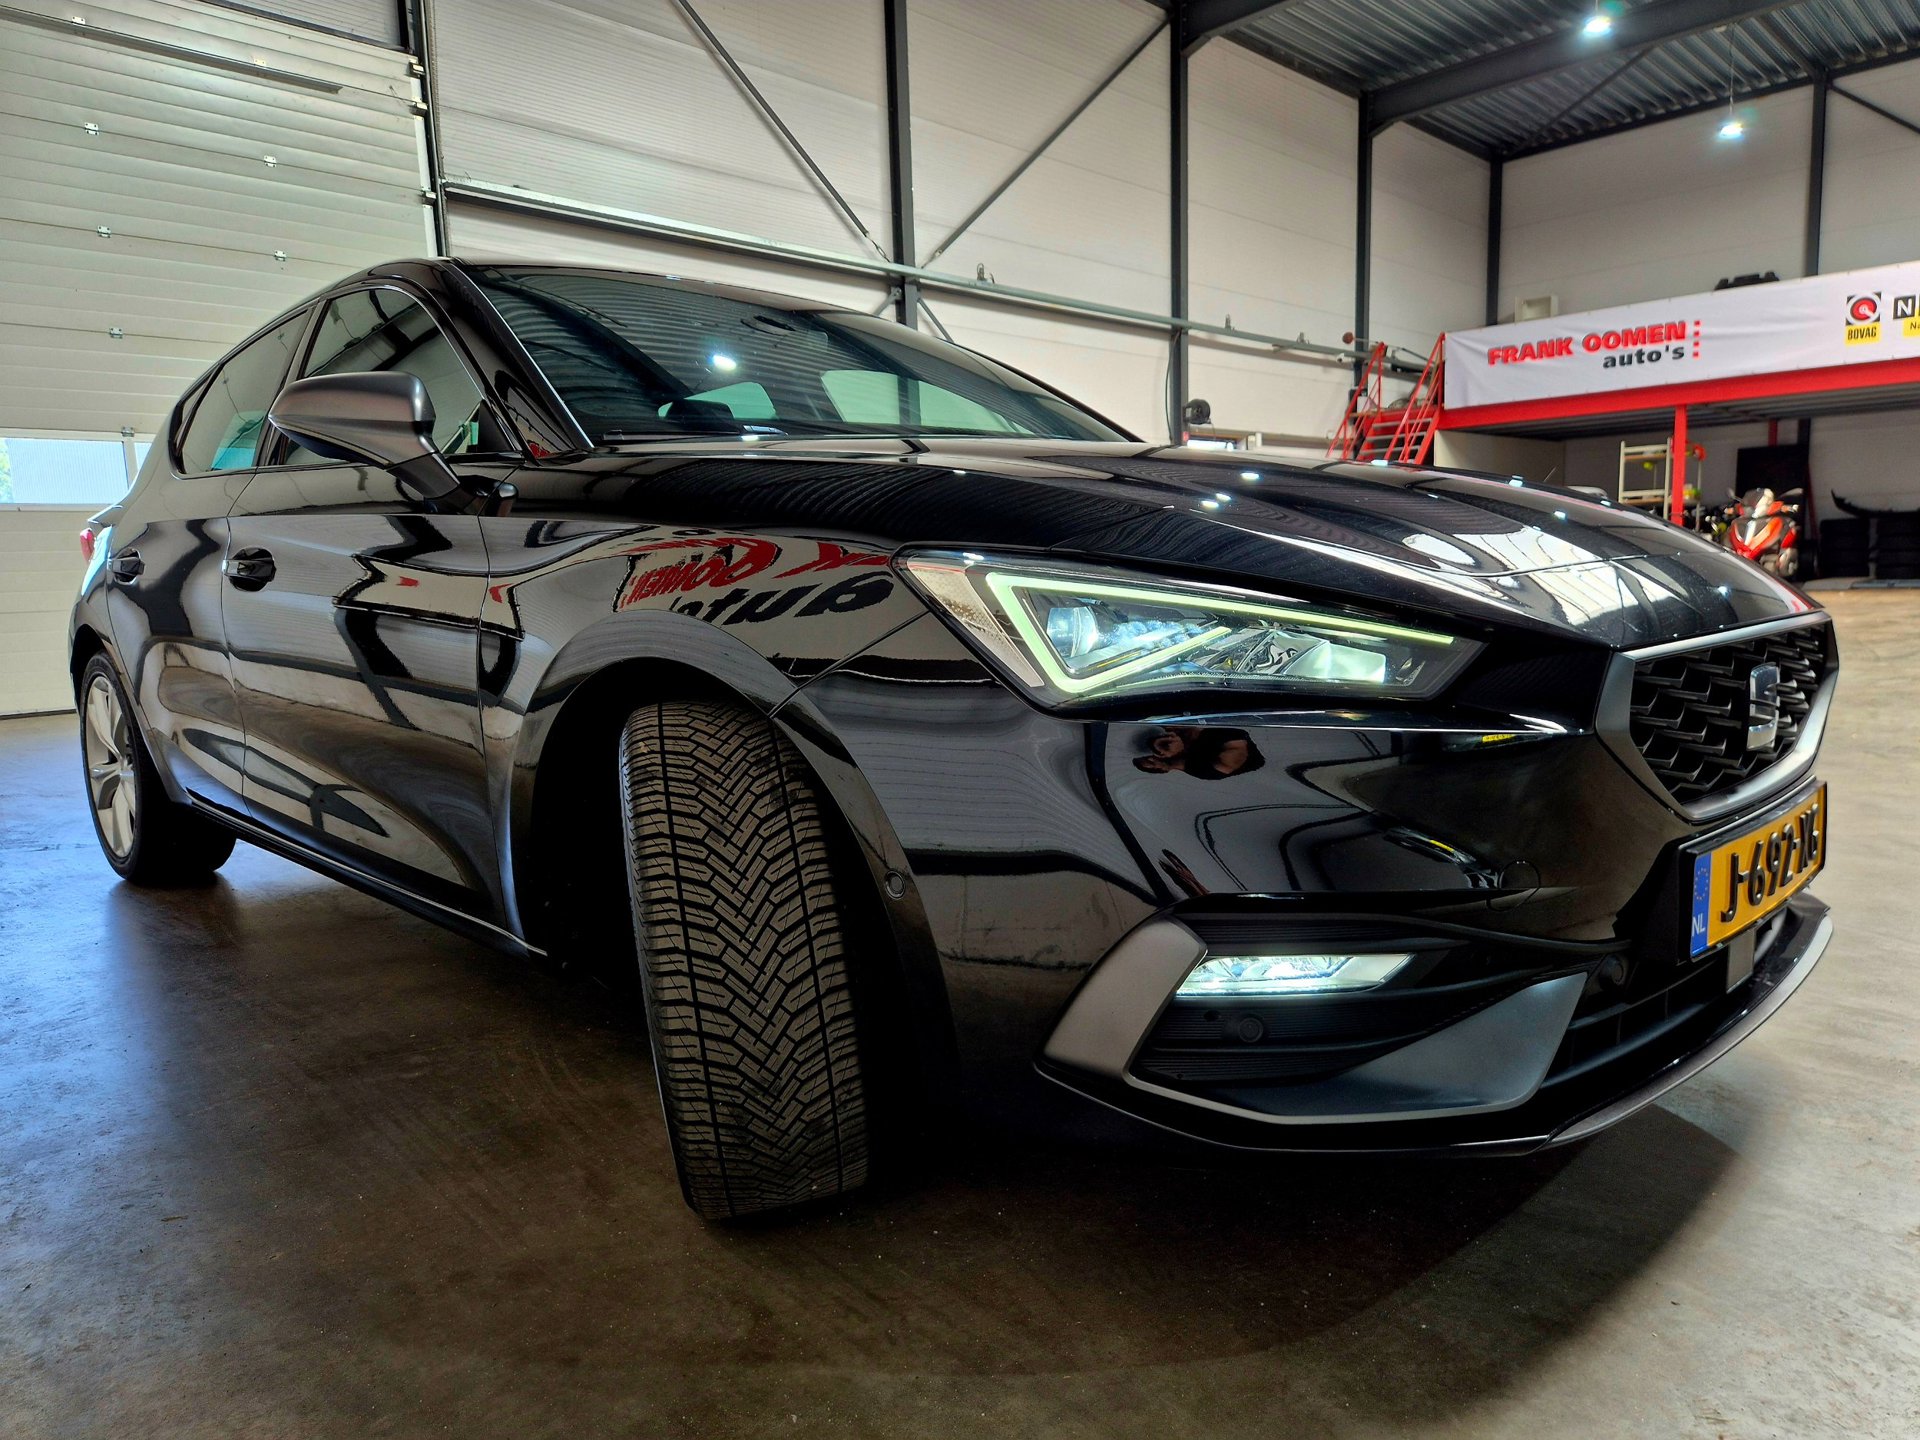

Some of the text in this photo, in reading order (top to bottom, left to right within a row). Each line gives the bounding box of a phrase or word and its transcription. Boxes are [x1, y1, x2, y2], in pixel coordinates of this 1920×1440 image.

[1488, 320, 1687, 366] FRANK OOMEN
[1847, 326, 1877, 341] BOVAG
[1602, 345, 1685, 369] auto's
[1692, 914, 1706, 937] NL
